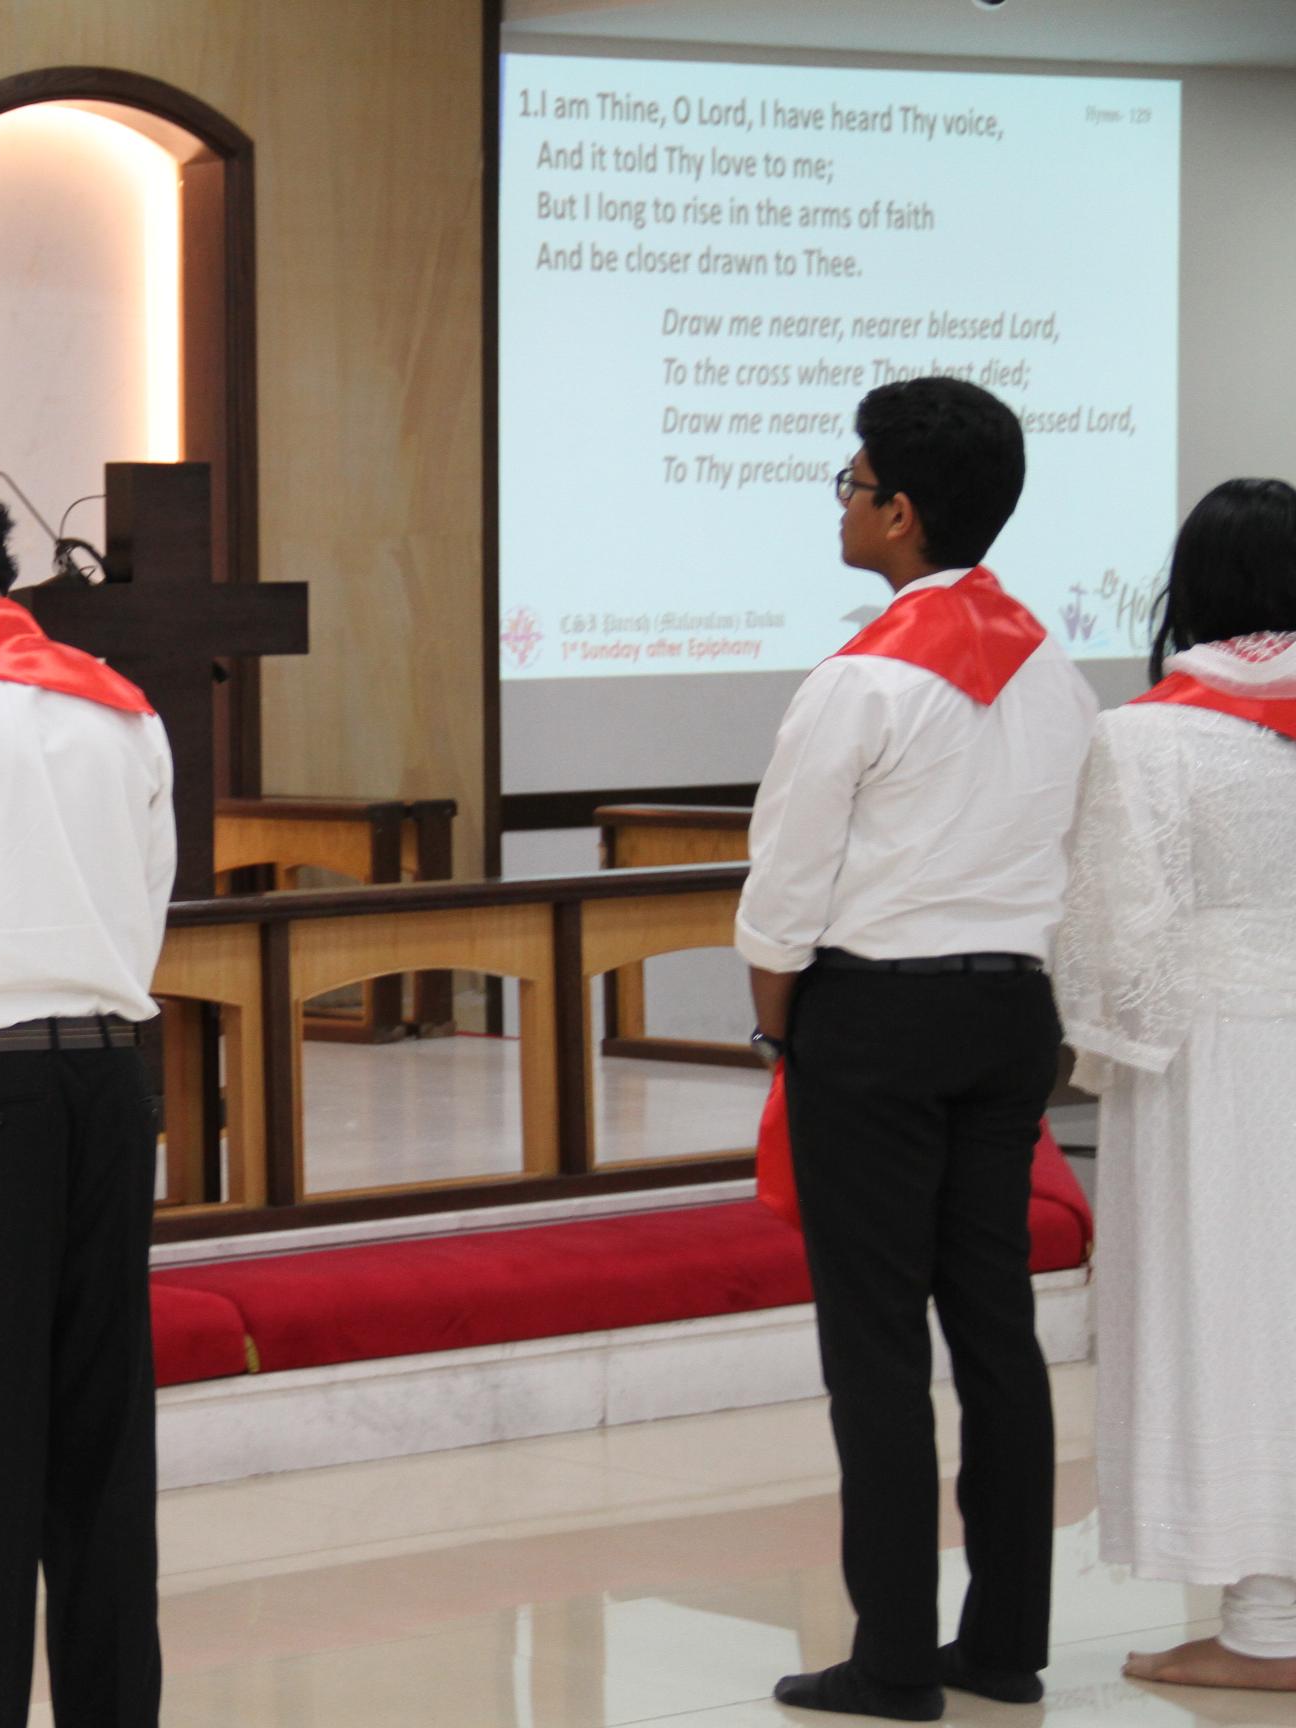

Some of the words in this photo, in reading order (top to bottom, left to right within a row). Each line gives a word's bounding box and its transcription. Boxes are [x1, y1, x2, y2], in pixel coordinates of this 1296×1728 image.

[554, 95, 591, 120] am
[596, 91, 668, 129] Thine,
[673, 95, 691, 125] O
[697, 97, 754, 133] Lord,
[760, 98, 767, 128] I
[772, 98, 825, 131] have
[830, 101, 894, 133] heard
[899, 104, 939, 142] Thy
[943, 107, 1005, 142] voice,
[536, 140, 584, 171] And
[590, 142, 607, 172] it
[612, 144, 658, 174] told
[664, 144, 704, 183] Thy
[711, 146, 757, 178] love
[763, 152, 787, 180] to
[792, 157, 835, 185] me;
[537, 190, 577, 222] But
[583, 192, 590, 222] I
[597, 191, 647, 231] long
[652, 197, 677, 225] to
[682, 196, 723, 226] rise
[728, 197, 749, 226] in
[755, 198, 793, 228] the
[798, 203, 853, 230] arms
[858, 199, 882, 230] of
[884, 199, 936, 231] faith
[536, 241, 583, 272] And
[590, 242, 618, 273] be
[624, 243, 692, 275] closer
[697, 245, 768, 276] drawn
[773, 250, 798, 277] to
[801, 248, 864, 279] Thee.
[661, 307, 723, 338] Draw
[727, 314, 764, 339] me
[768, 316, 846, 344] nearer,
[850, 315, 923, 340] nearer
[926, 311, 1005, 341] blessed
[1009, 311, 1062, 344] Lord,
[662, 357, 688, 386] To
[693, 357, 730, 387] the
[735, 362, 792, 387] cross
[796, 357, 865, 387] where
[979, 357, 1033, 391] died;
[661, 405, 723, 436] Draw
[727, 412, 764, 436] me
[768, 412, 846, 441] nearer,
[1018, 405, 1083, 434] lessed
[1087, 406, 1138, 436] Lord,
[662, 455, 688, 485] To
[693, 455, 735, 491] Thy
[580, 640, 641, 662] Sunday
[687, 636, 762, 660] Epiphany
